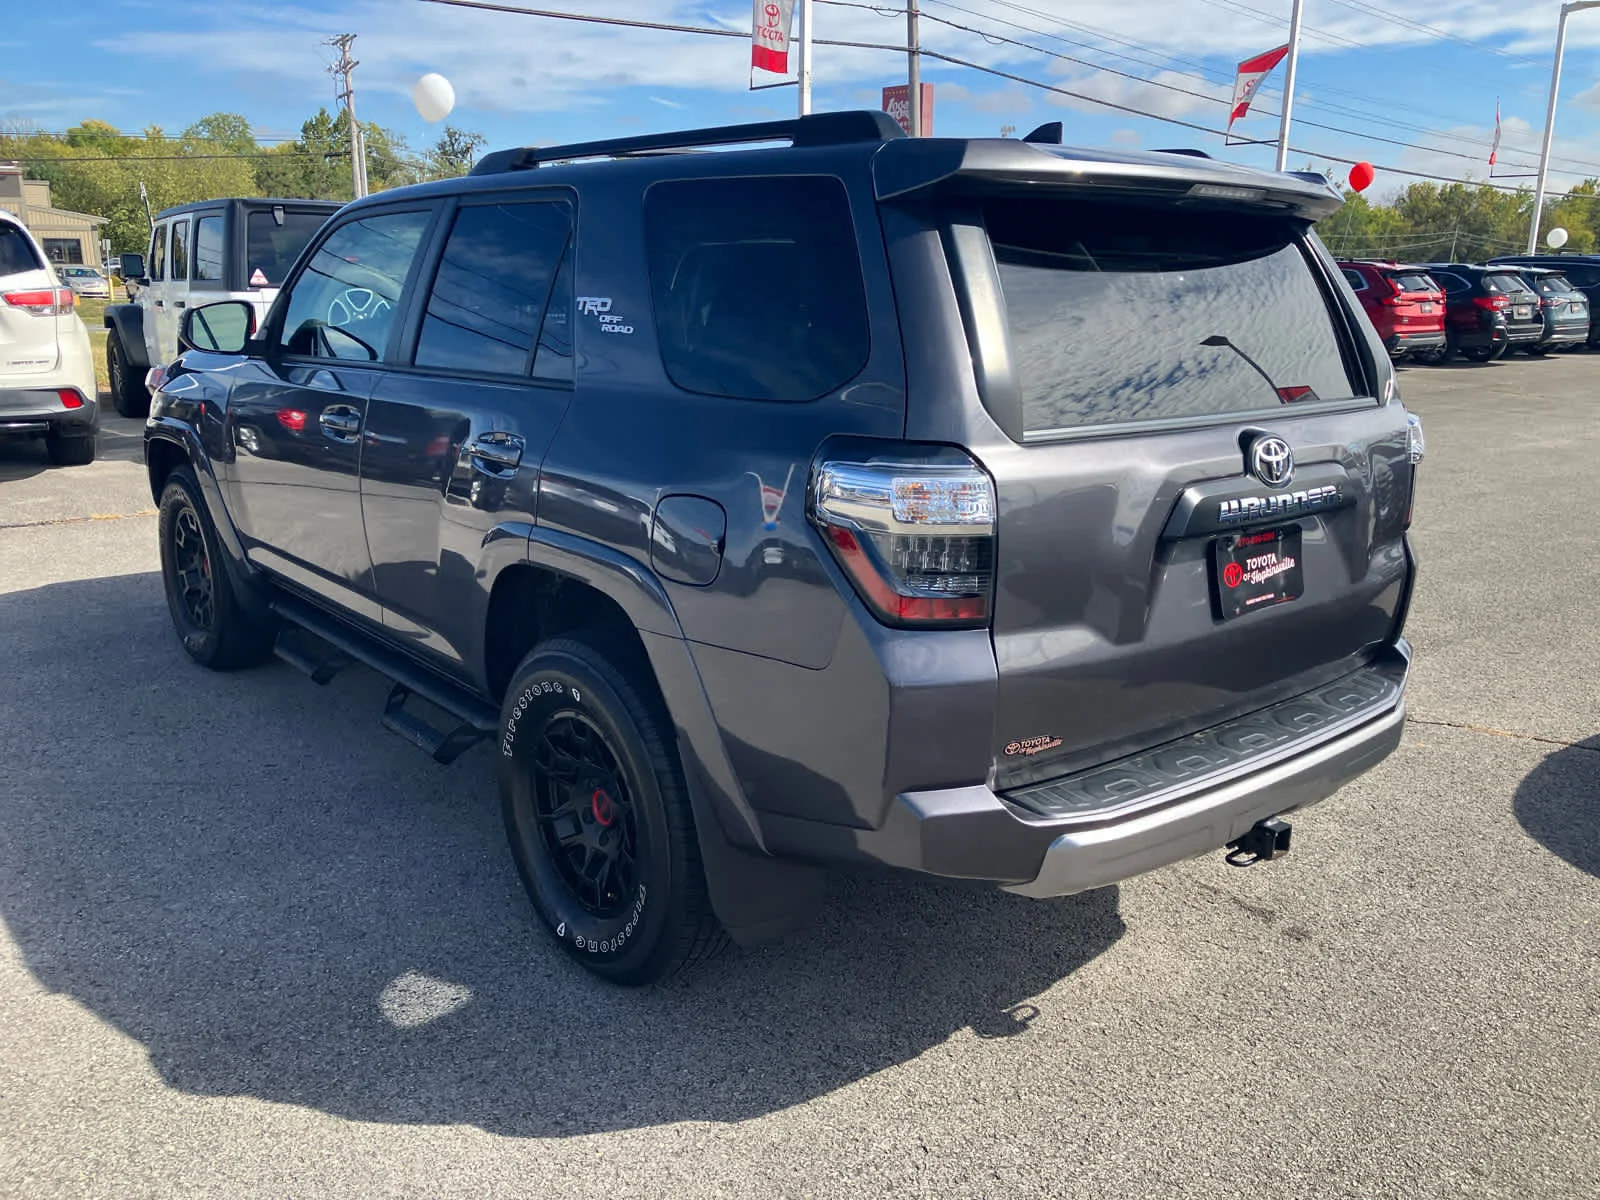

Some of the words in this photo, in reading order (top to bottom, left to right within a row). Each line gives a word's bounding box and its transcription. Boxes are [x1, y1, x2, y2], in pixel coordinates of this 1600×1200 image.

[576, 296, 612, 316] TRD
[599, 315, 624, 323] OFF
[601, 324, 634, 334] ROAD
[1245, 552, 1278, 571] TOYOTA
[502, 681, 564, 757] Firestone
[1021, 736, 1050, 748] TOYOTA
[575, 884, 647, 953] Firestone
